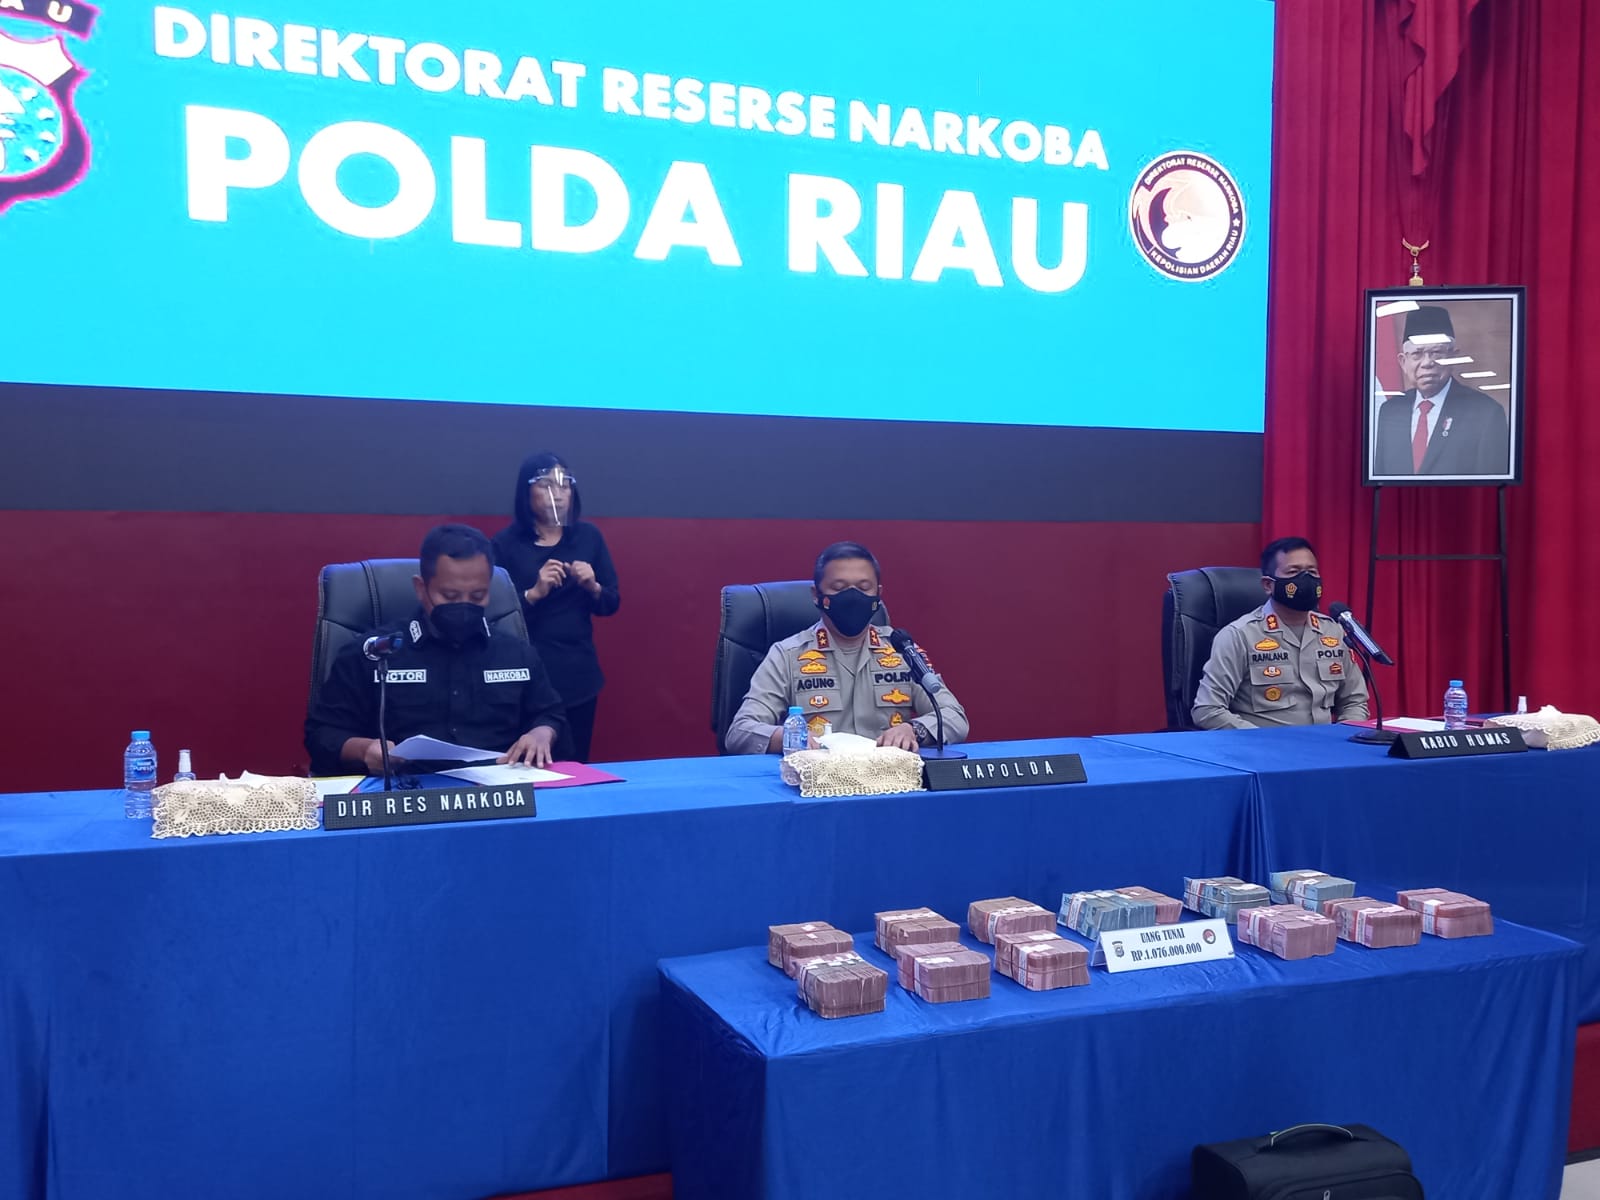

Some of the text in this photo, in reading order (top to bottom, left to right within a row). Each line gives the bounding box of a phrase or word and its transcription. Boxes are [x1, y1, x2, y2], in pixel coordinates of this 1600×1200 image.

[154, 5, 1109, 170] DIREKTORAT RESERSE NARKOBA
[185, 104, 1088, 293] POLDA RIAU
[1150, 250, 1199, 275] KEPOLISIAN
[1225, 229, 1239, 252] RIAU
[487, 671, 527, 681] NARKOBA
[797, 677, 834, 691] AGUNG
[1419, 732, 1511, 749] KABID HUMAS
[962, 760, 1054, 779] KAPOLDA
[337, 789, 525, 817] DIR RES NARKOBA
[1140, 927, 1186, 944] UANG TUNAI
[1130, 942, 1202, 962] RP.1.076.000.000
